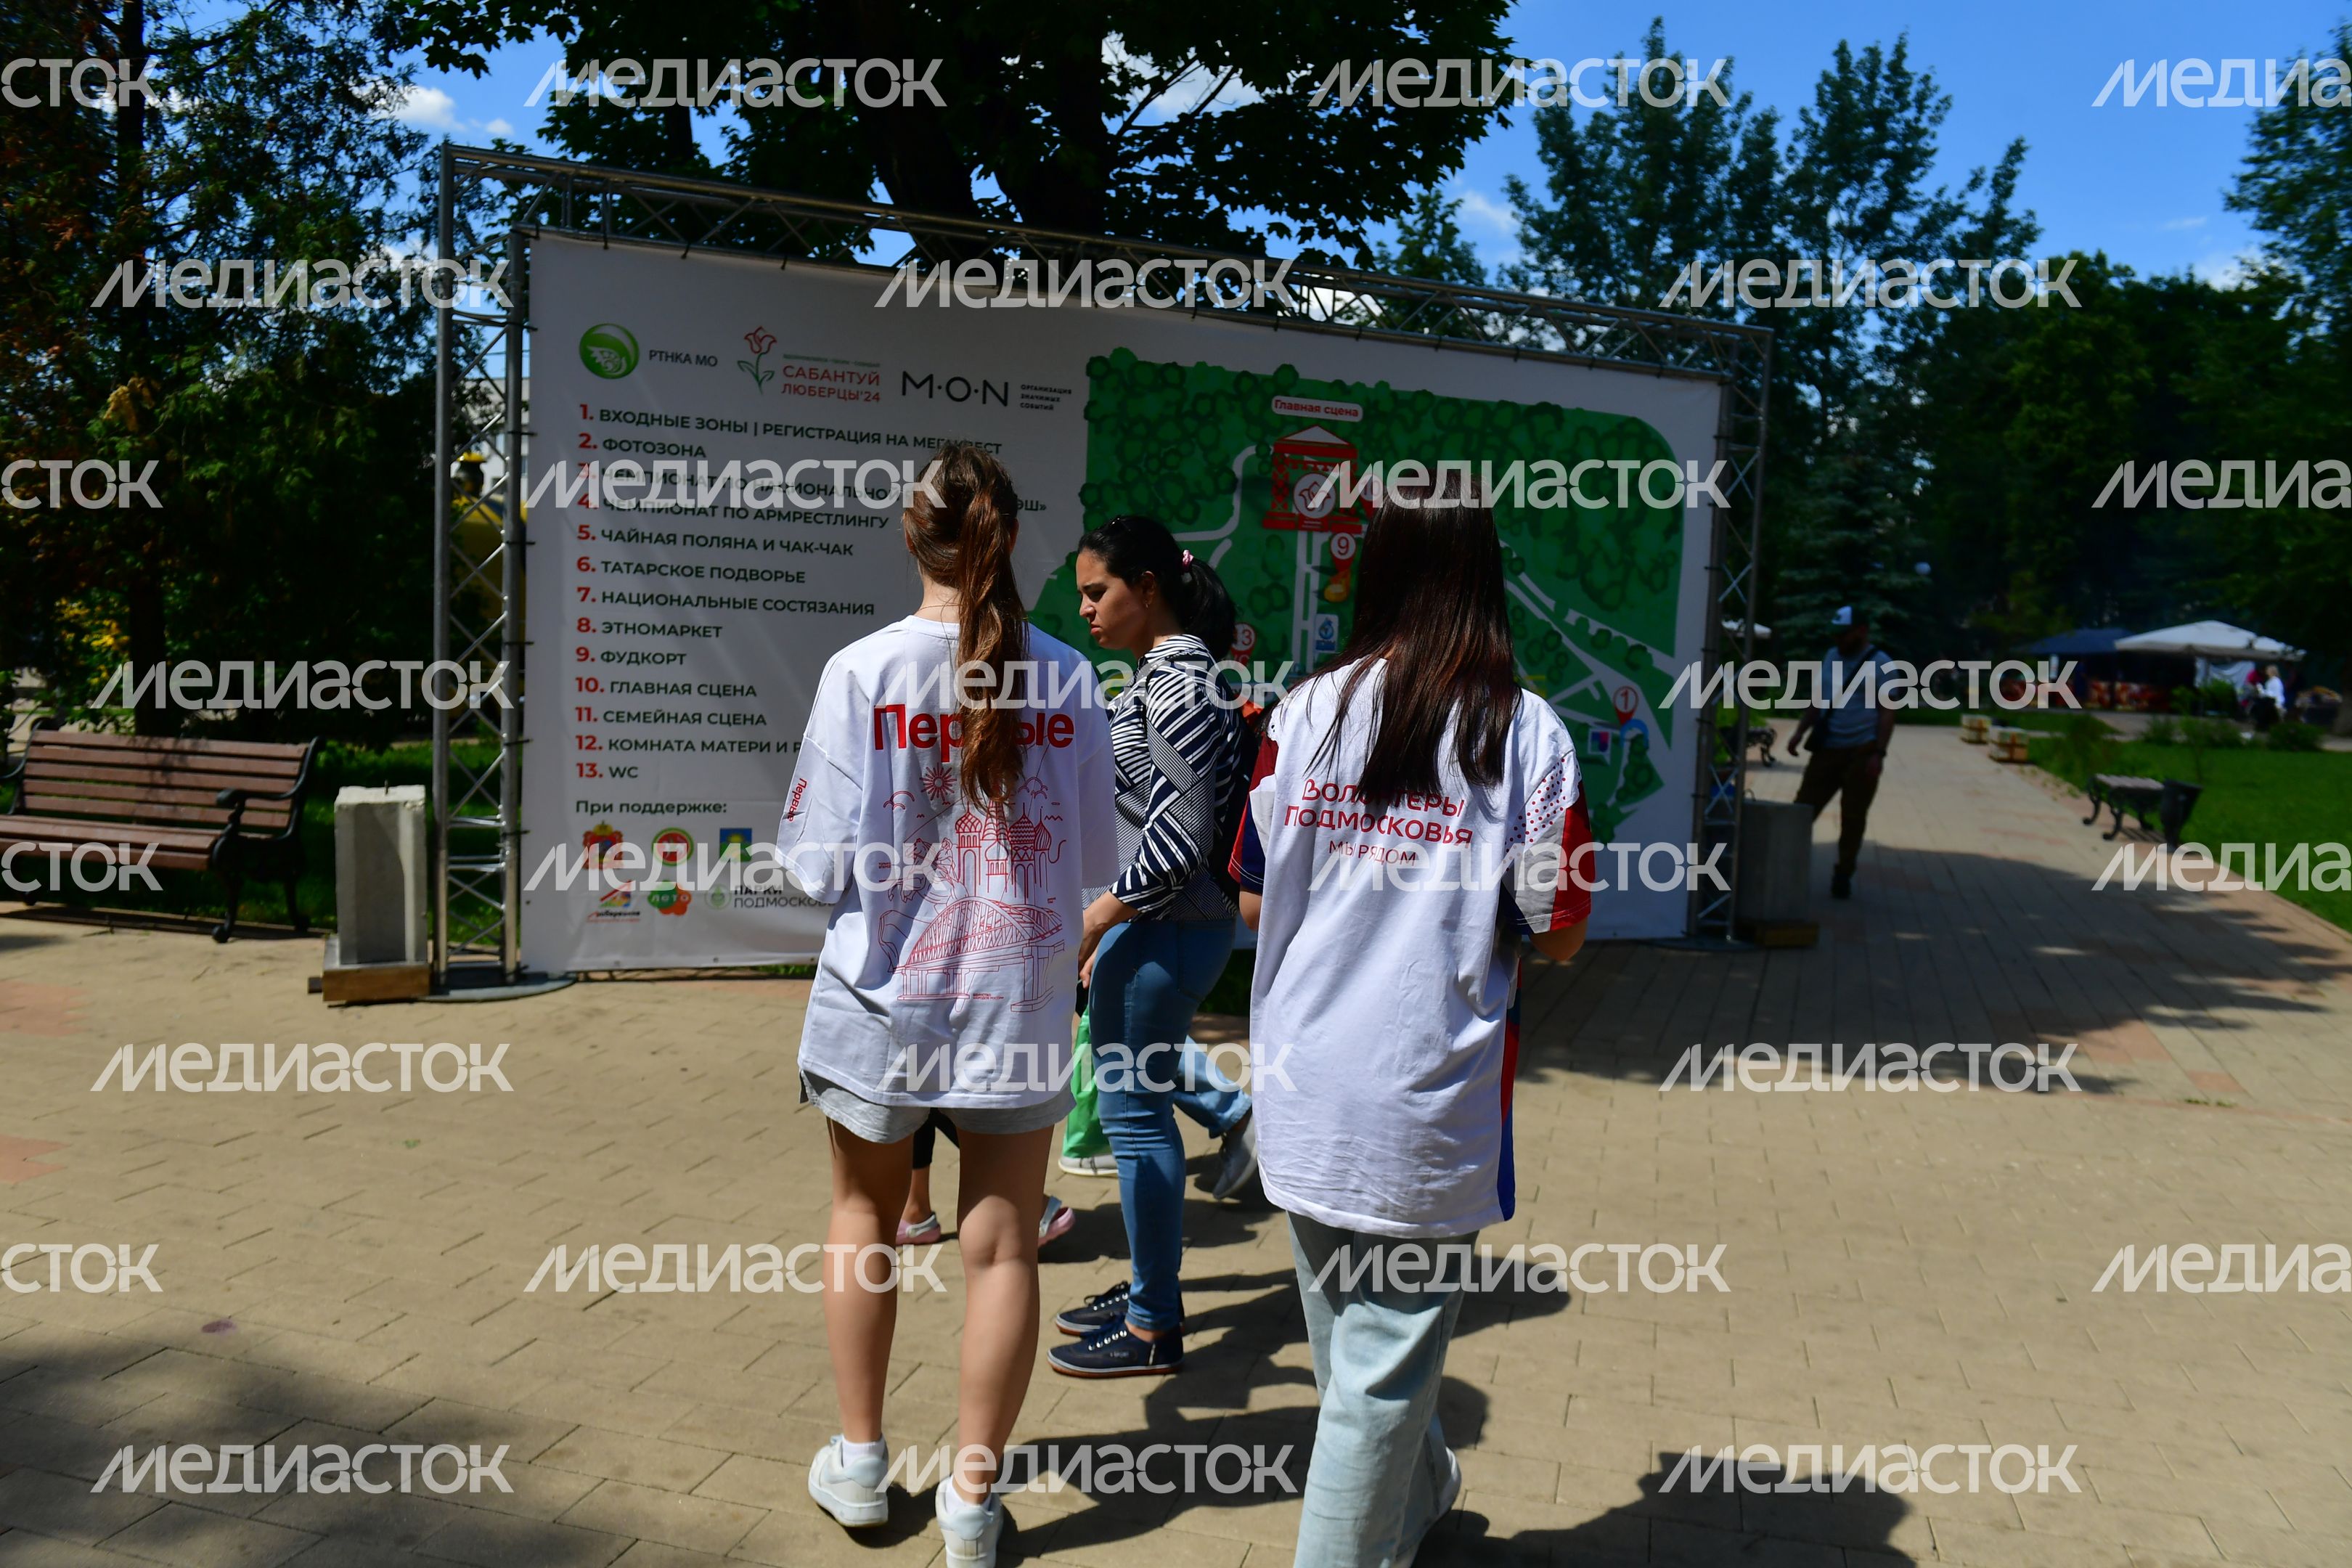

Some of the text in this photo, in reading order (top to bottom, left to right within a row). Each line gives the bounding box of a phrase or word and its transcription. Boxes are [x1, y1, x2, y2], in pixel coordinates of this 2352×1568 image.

[649, 350, 718, 367] РТНКА МО
[783, 365, 881, 386] САБАНТУЙ
[1274, 399, 1359, 418] Главная сцена
[579, 404, 594, 420] 1.
[600, 409, 690, 429] ВХОДНЫЕ
[695, 418, 748, 433] ЗОНЫ
[763, 423, 881, 445] РЕГИСТРАЦИЯ
[886, 434, 909, 446] НА
[579, 433, 707, 458] 2. ФОТОЗОНА
[601, 467, 717, 489] ЧЕМПИОНАТ
[722, 477, 747, 490] ПО
[577, 494, 889, 529] 4. ЧЕМПИОНАТ ПО АРМРЕСТЛИНГУ
[577, 524, 854, 556] 5. ЧАЙНАЯ ПОЛЯНА И ЧАК-ЧАК
[1337, 536, 1349, 556] 9
[576, 556, 807, 583] 6. ТАТАРСКОЕ ПОДВОРЬЕ
[576, 587, 875, 616] 7. НАЦИОНАЛЬНЫЕ СОСТЯЗАНИЯ
[576, 616, 722, 639] 8. ЭТНОМАРКЕТ
[576, 647, 687, 666] 9. ФУДКОРТ
[576, 677, 757, 698] 10. ГЛАВНАЯ СЦЕНА
[1620, 689, 1628, 710] 1
[576, 706, 767, 727] 11. СЕМЕЙНАЯ СЦЕНА
[874, 703, 1074, 763] Перые
[576, 735, 603, 751] 12.
[608, 738, 696, 754] КОМНАТА
[702, 739, 772, 754] МАТЕРИ
[777, 741, 788, 754] И
[576, 763, 639, 779] 13. WC
[576, 800, 727, 817] При поддержке:
[788, 778, 807, 822] Первые
[1284, 805, 1474, 848] ПОДМОСКОВЬЯ
[1328, 840, 1416, 866] МЫ РЯДОМ
[734, 885, 783, 896] ПАРКИ
